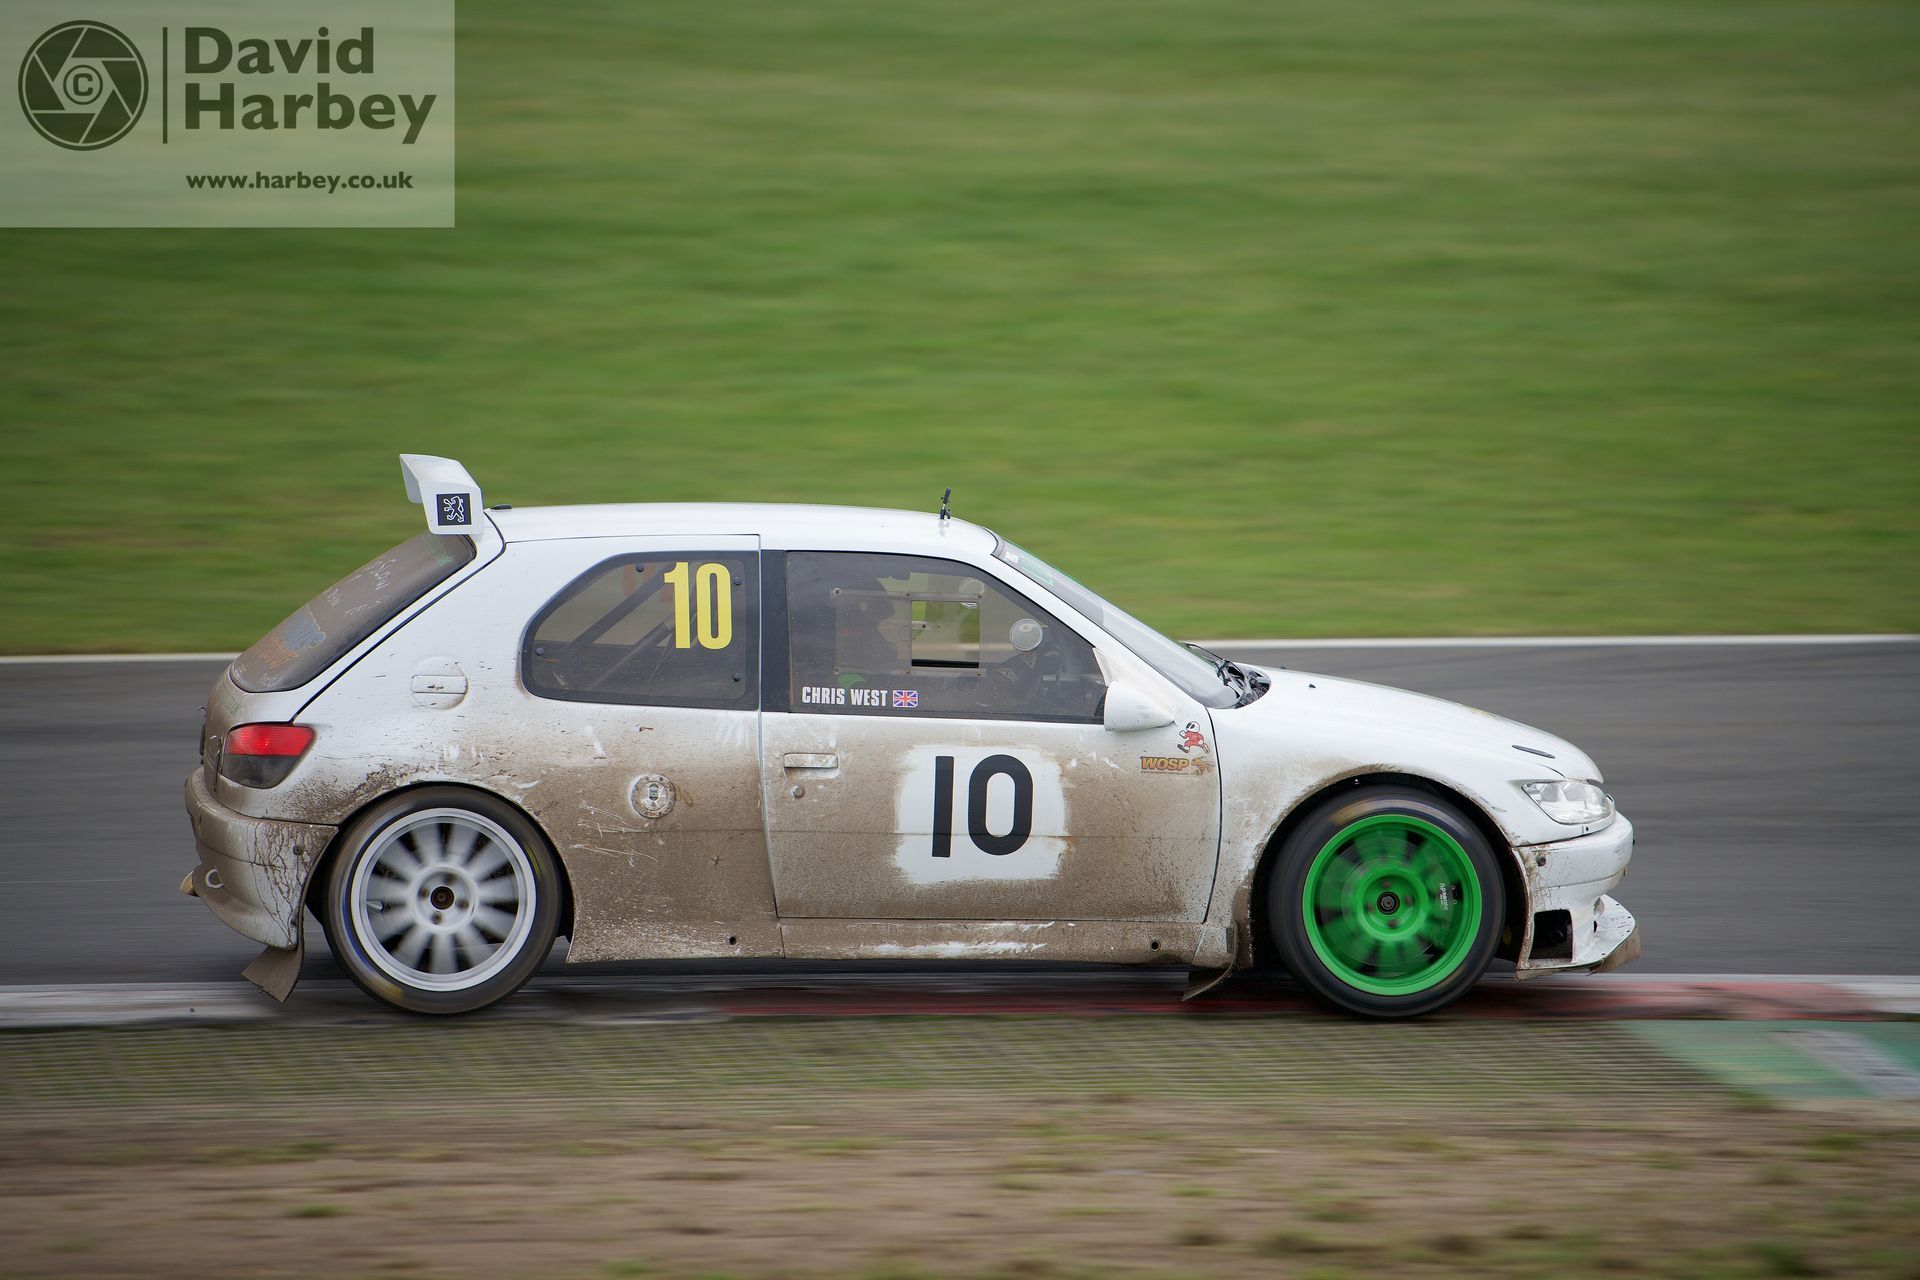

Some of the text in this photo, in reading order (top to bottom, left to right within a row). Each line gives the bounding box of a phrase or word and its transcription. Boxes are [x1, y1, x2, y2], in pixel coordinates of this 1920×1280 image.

[664, 562, 732, 649] 10
[801, 686, 888, 707] CHRIS WEST
[1140, 756, 1189, 771] WOSP
[932, 754, 1033, 858] 10
